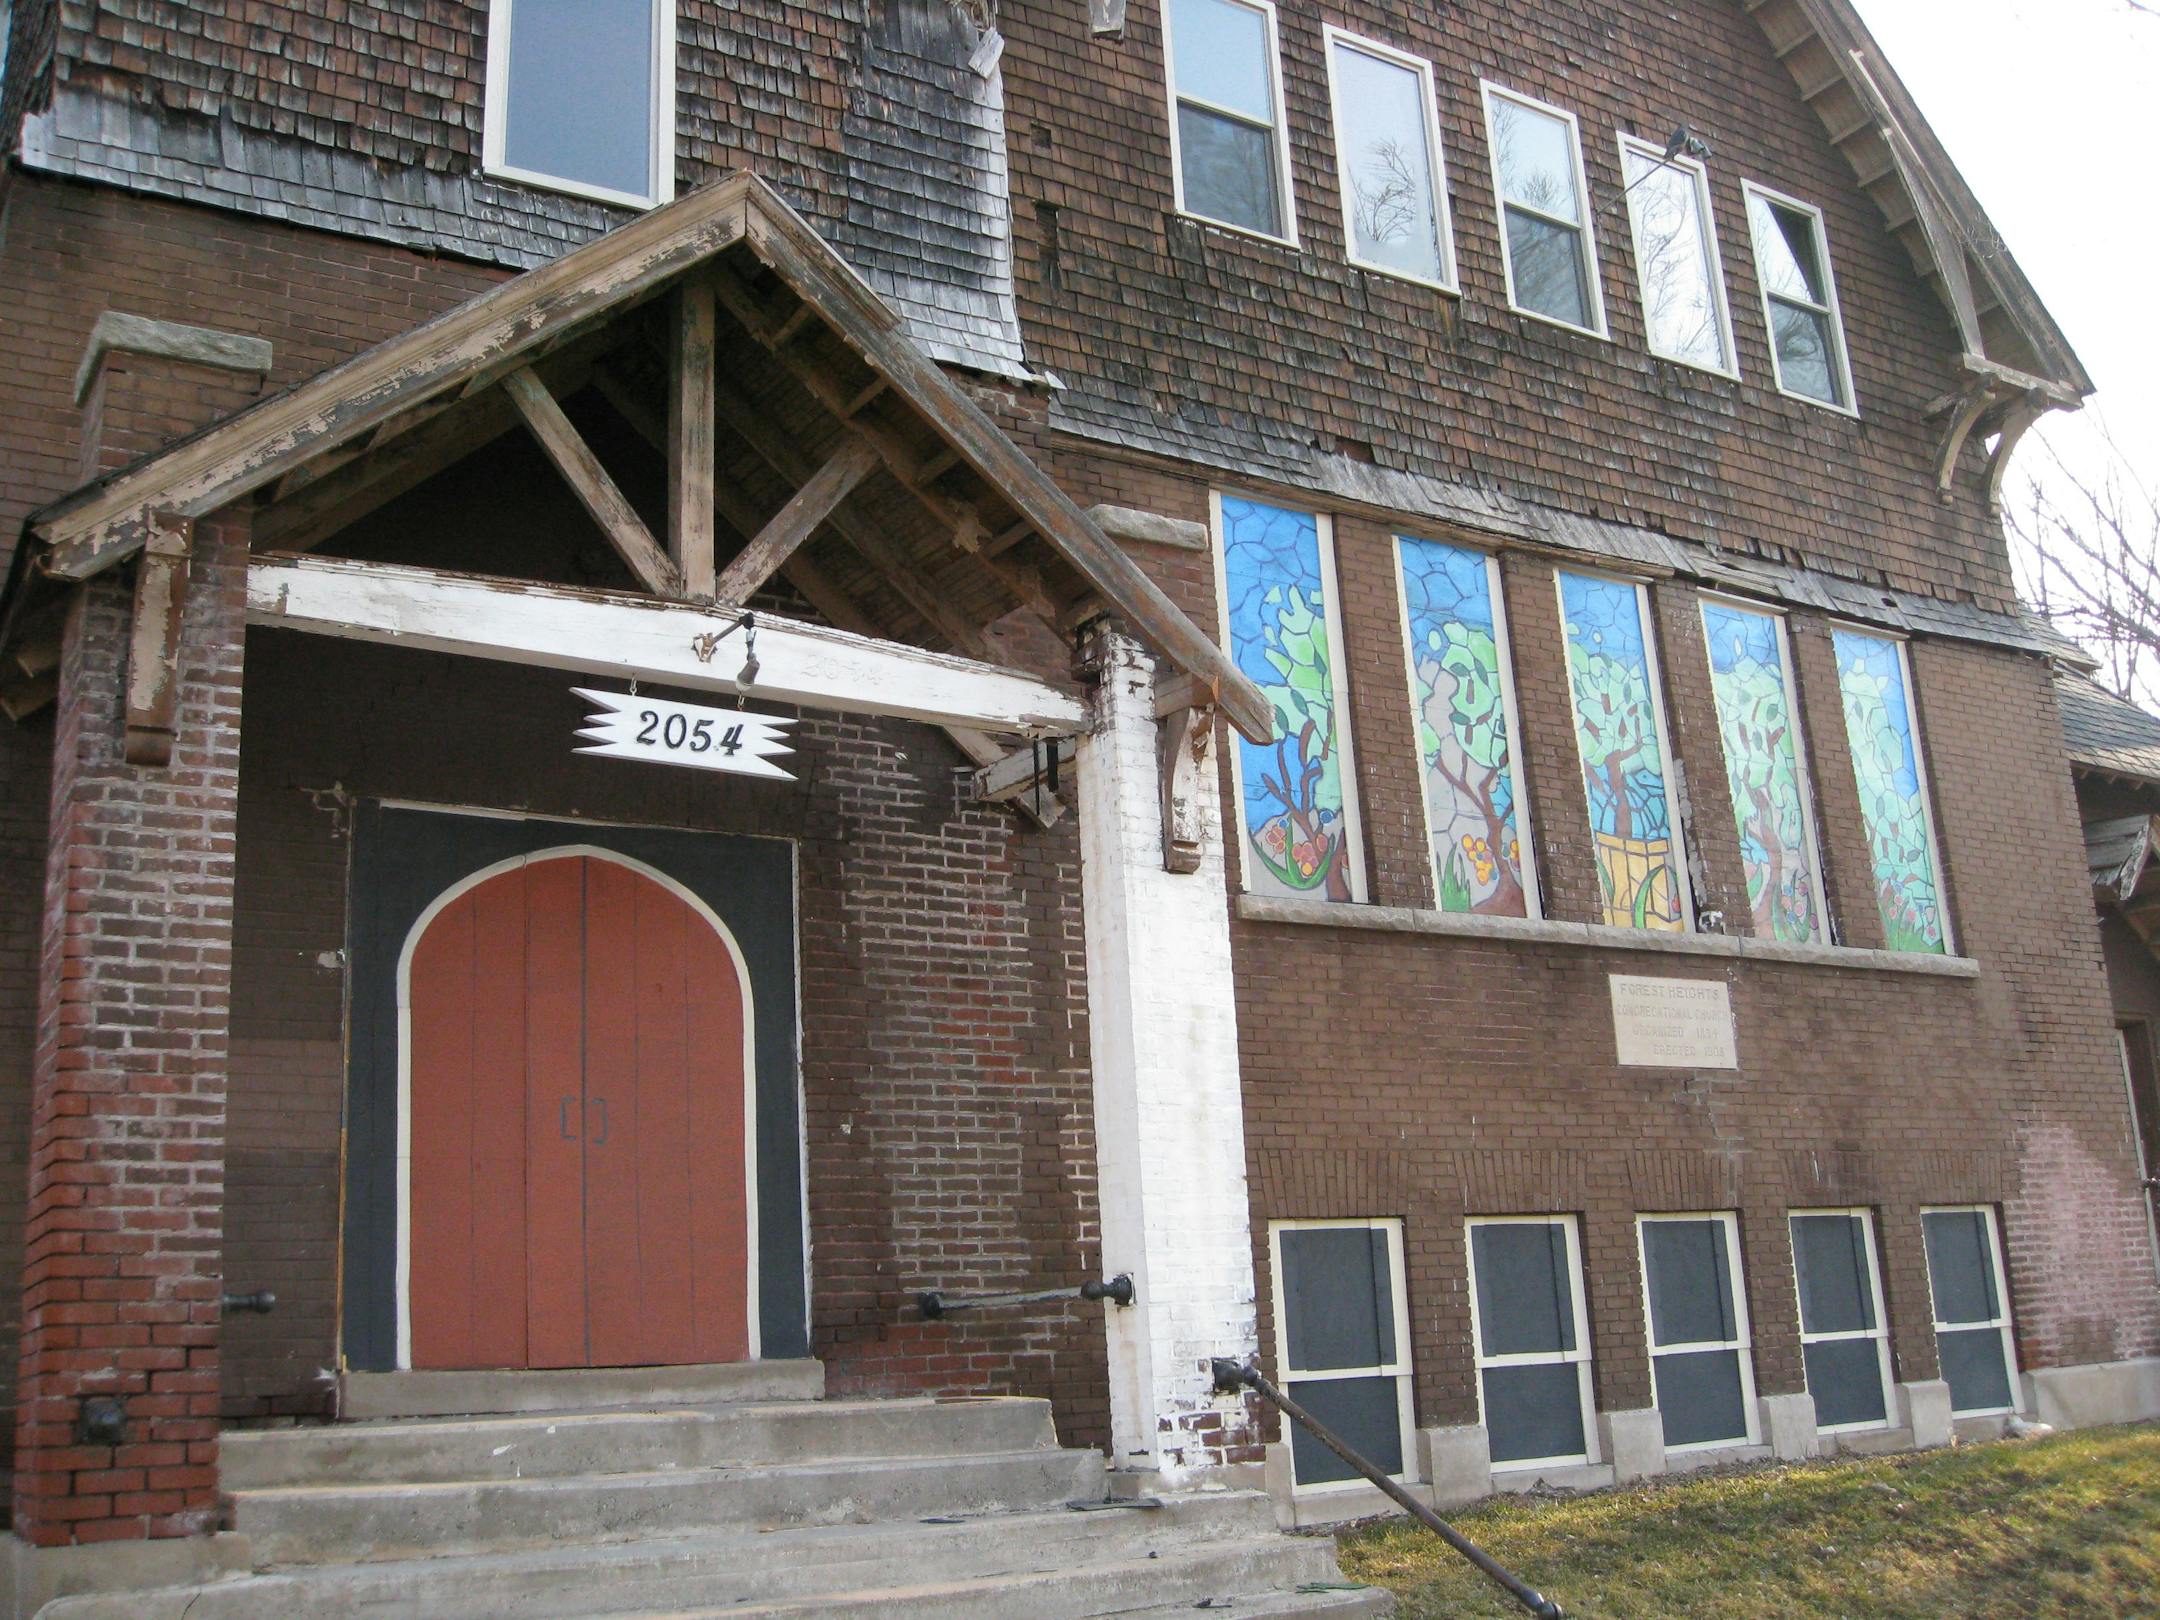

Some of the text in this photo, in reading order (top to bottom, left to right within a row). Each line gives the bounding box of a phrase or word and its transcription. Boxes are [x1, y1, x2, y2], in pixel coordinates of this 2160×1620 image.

[636, 710, 744, 756] 2054
[1620, 983, 1719, 1000] FOREST HEIGHTS
